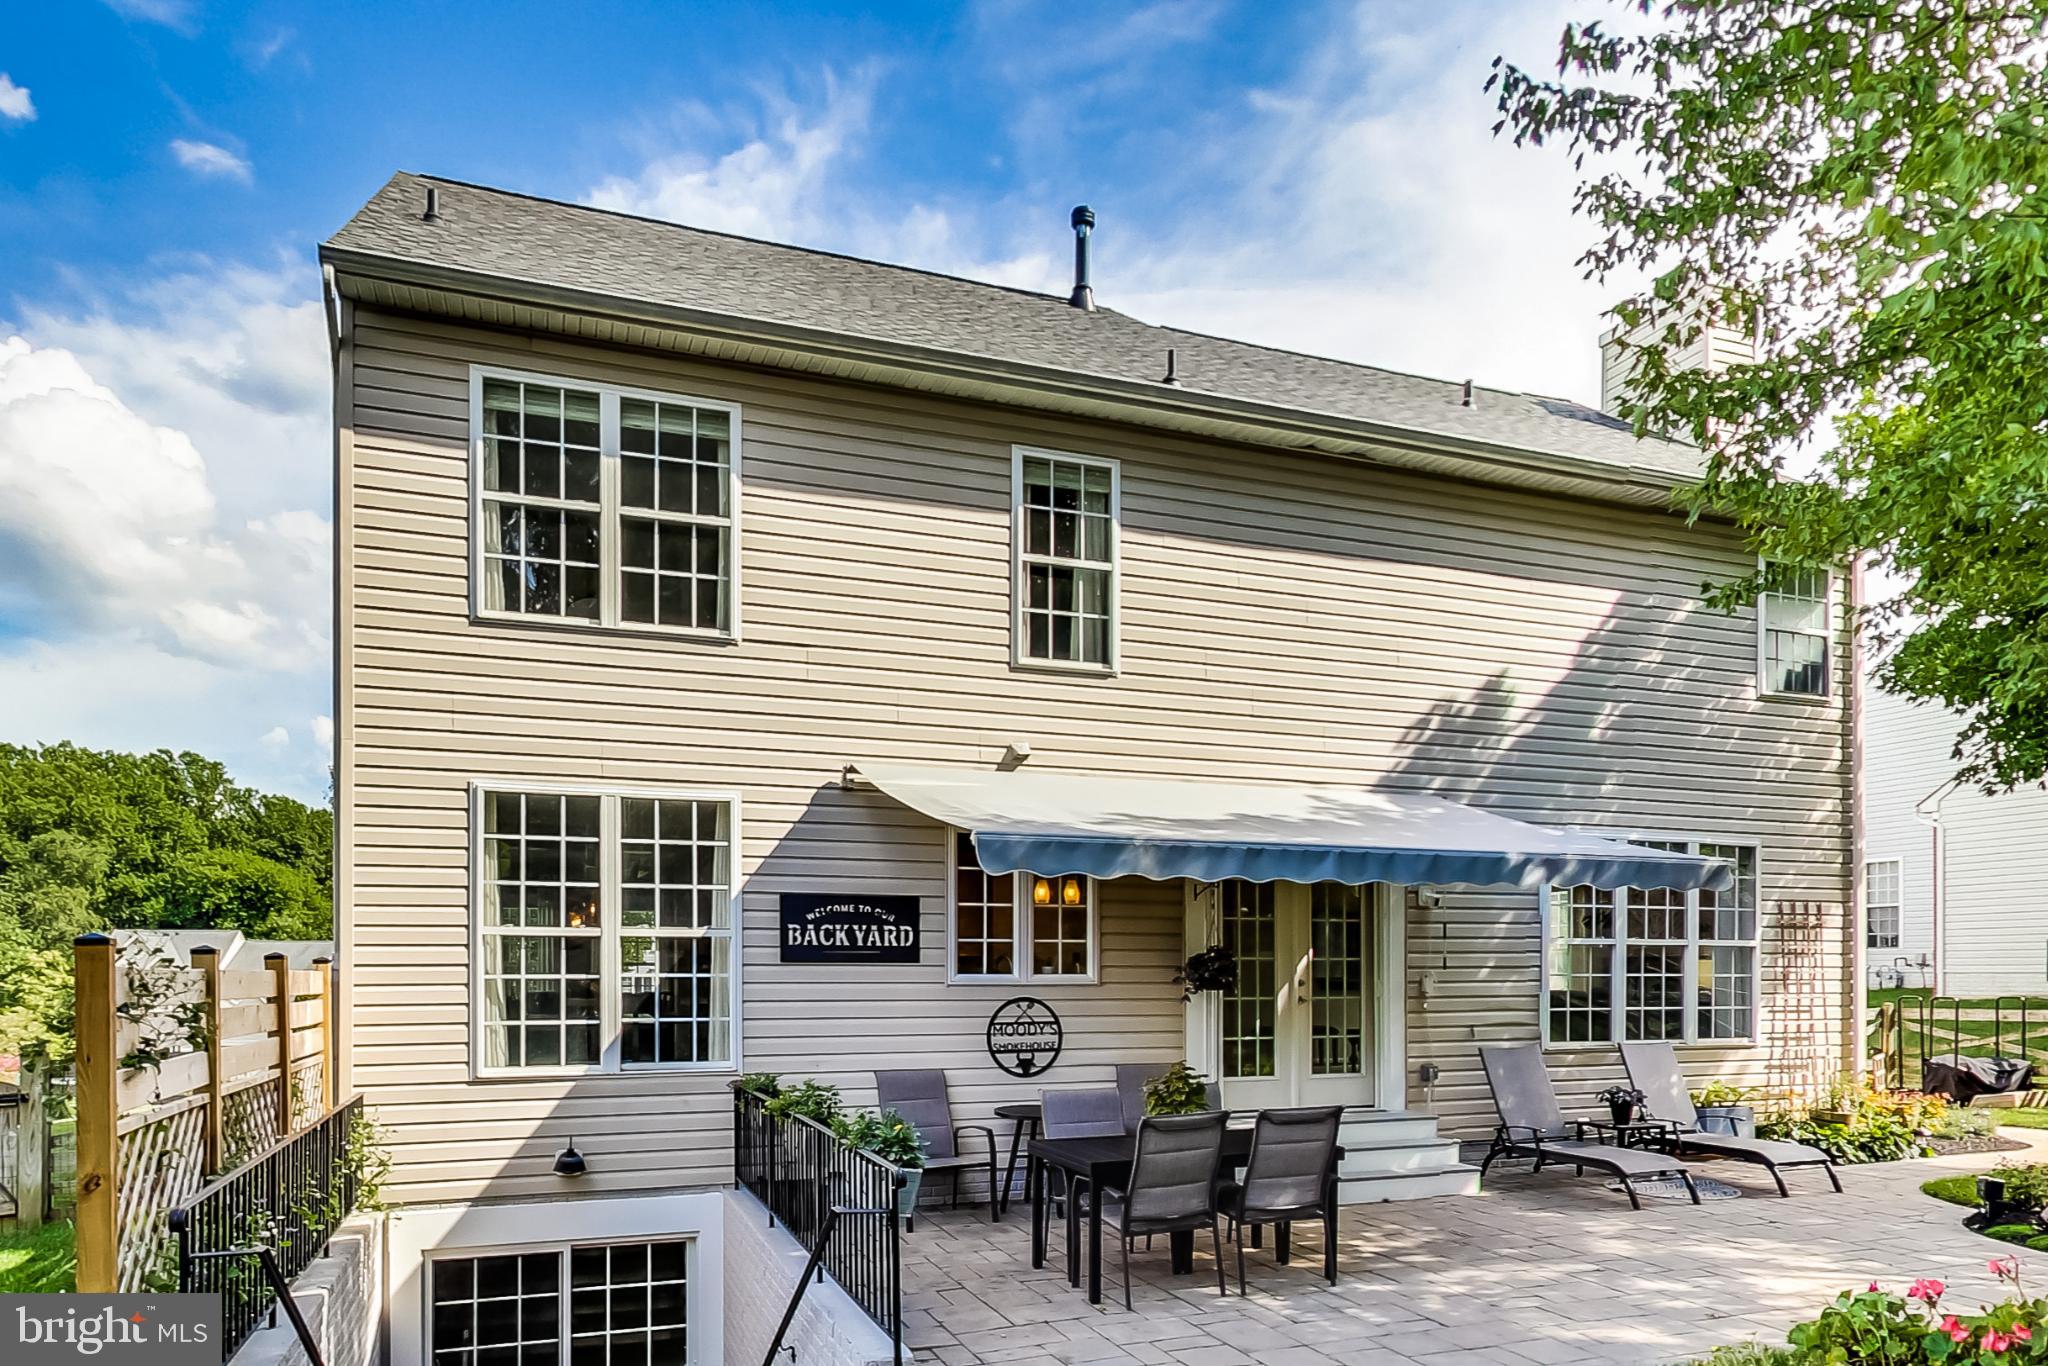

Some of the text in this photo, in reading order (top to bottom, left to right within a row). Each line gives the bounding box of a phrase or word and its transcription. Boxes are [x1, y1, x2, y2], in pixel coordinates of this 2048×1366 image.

[805, 904, 896, 922] WELCOME TO OUR
[787, 924, 914, 947] BACKYARD
[993, 1023, 1058, 1037] MOODY'S
[993, 1041, 1057, 1051] SMOKEHOUSE
